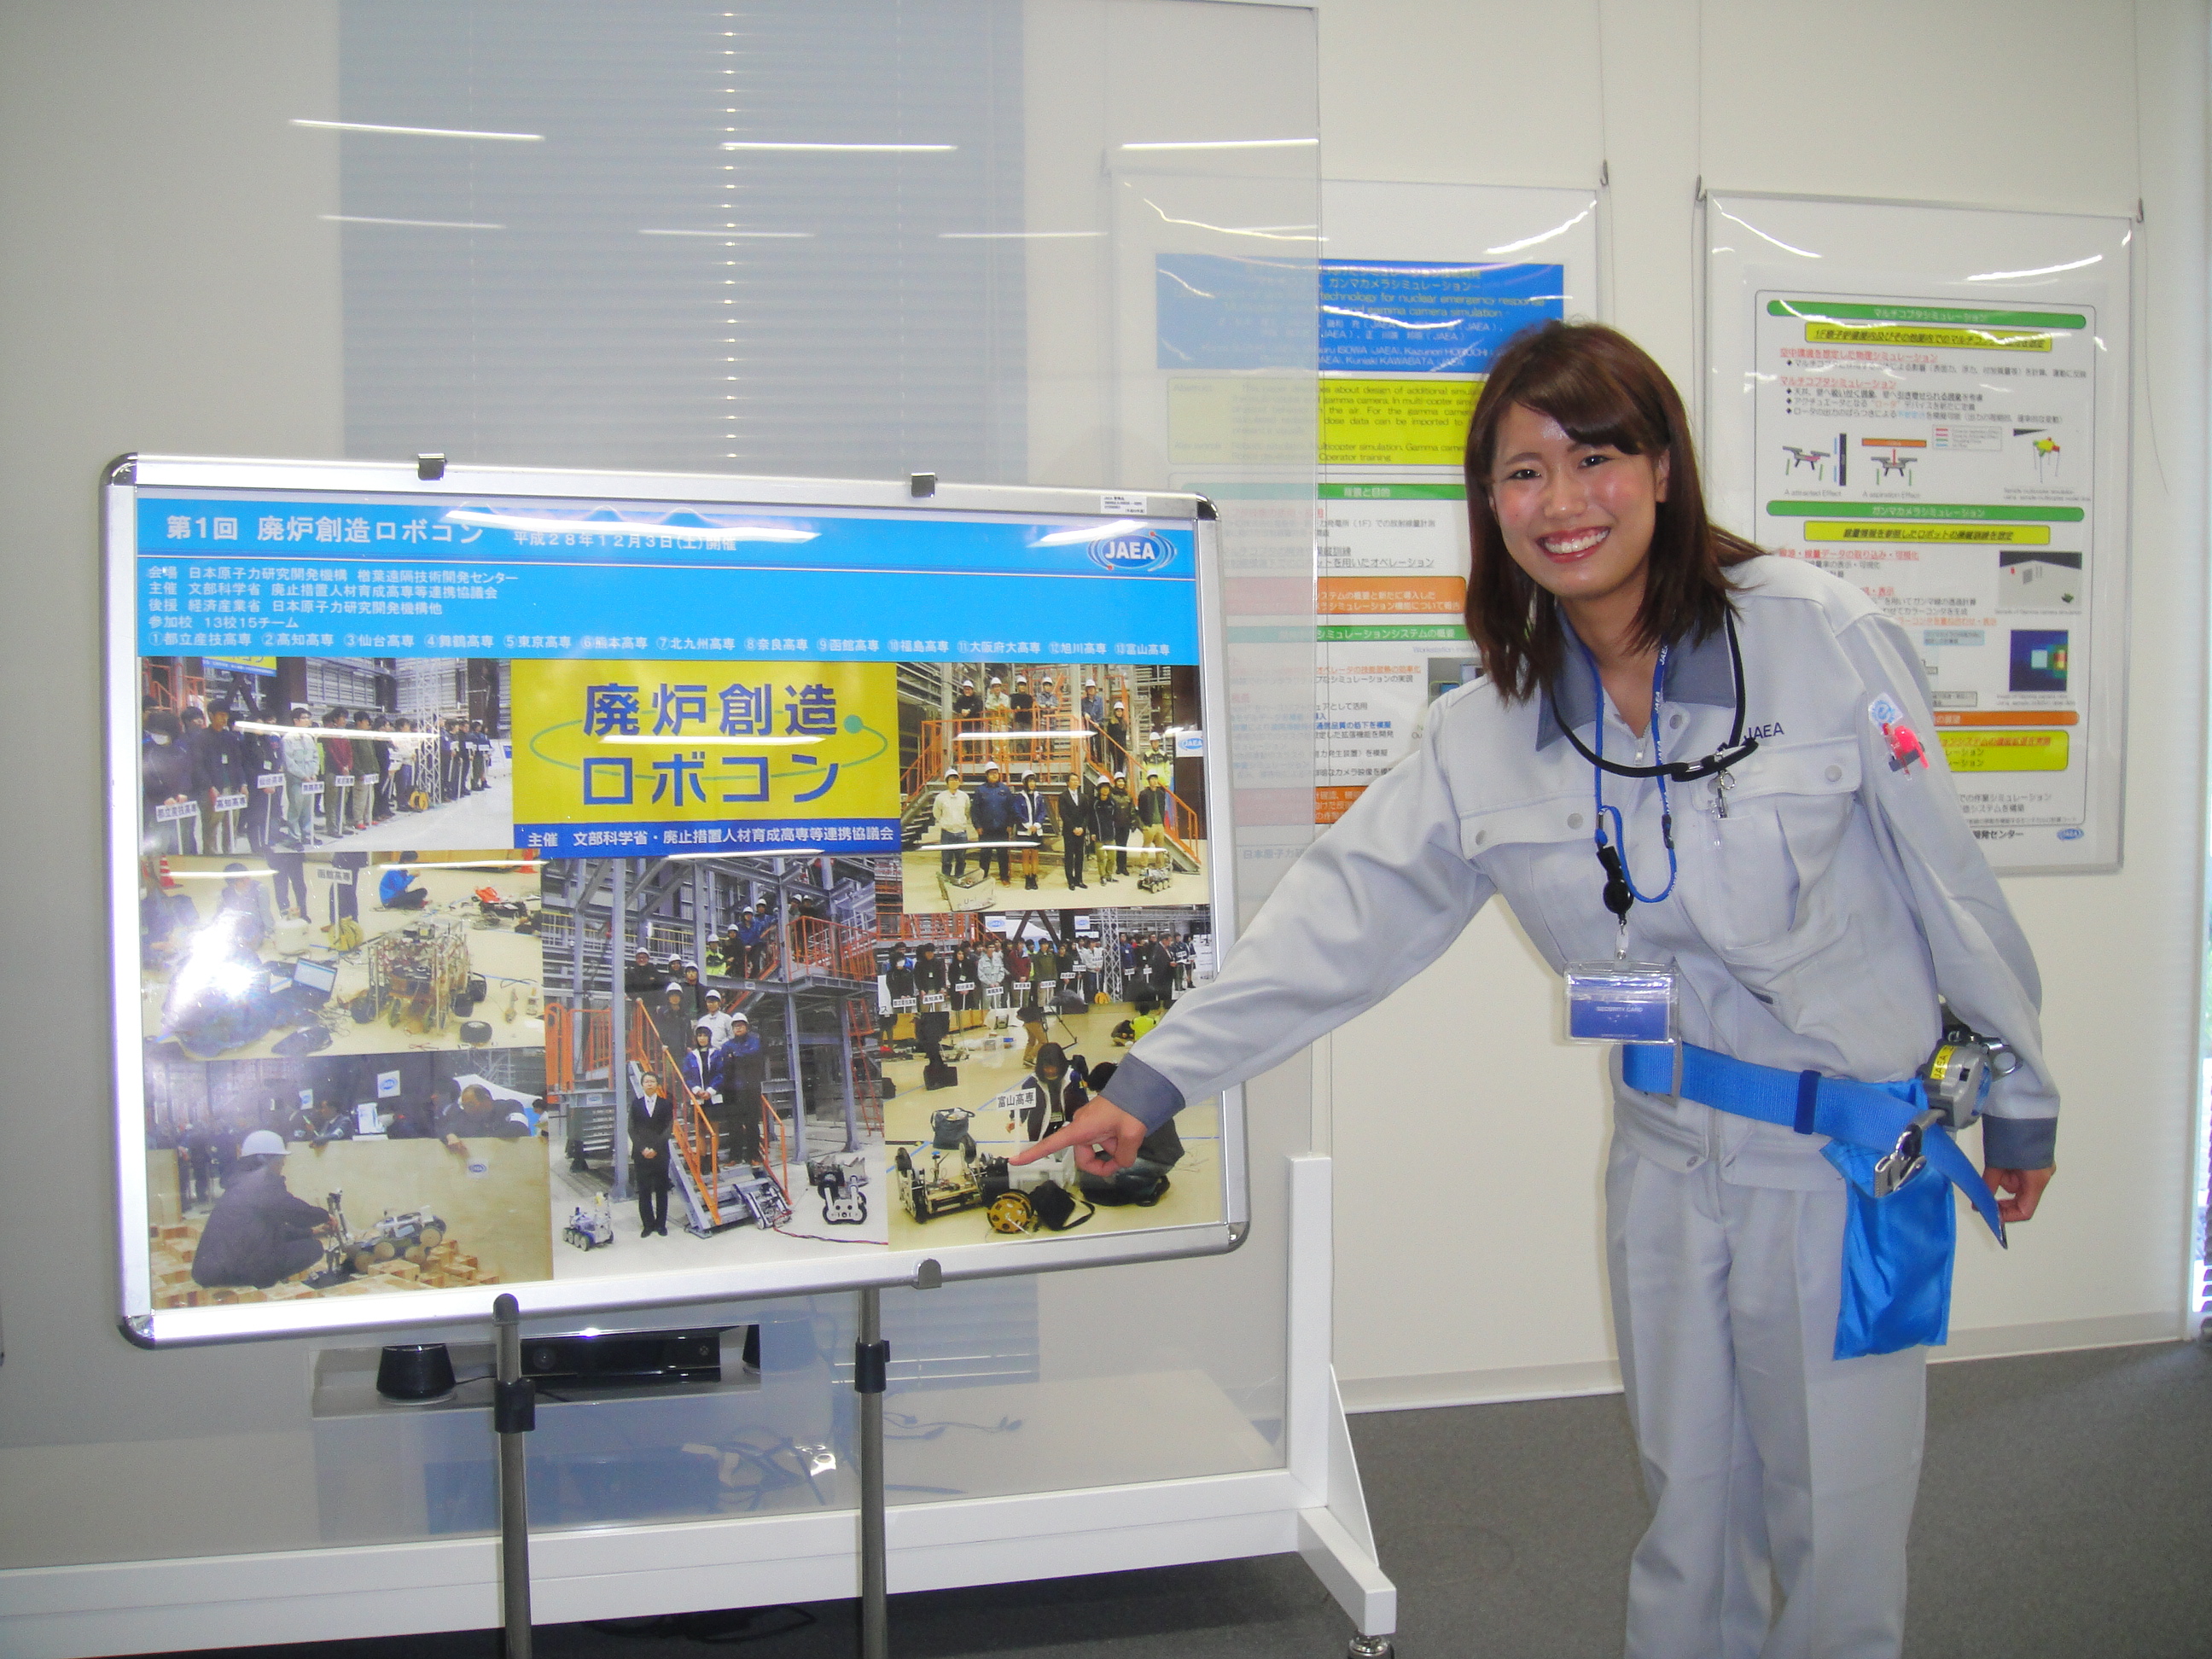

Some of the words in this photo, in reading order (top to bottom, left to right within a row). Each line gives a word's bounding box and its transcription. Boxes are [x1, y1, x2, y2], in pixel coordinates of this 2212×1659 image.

[166, 515, 238, 540] 第1回
[257, 515, 484, 544] 廃炉創造ロボコン
[1104, 540, 1156, 561] JAEA
[148, 566, 178, 580] 会場
[189, 567, 348, 582] 日本原子力研究開発機構
[357, 568, 519, 585] 楢葉遠隔技術開発センター
[148, 581, 178, 596] 主催
[188, 582, 261, 597] 文部科学省
[148, 598, 178, 613] 後援
[188, 599, 261, 614] 経済産業省
[271, 599, 443, 615] 日本原子力研究開発機構他
[148, 615, 193, 630] 参加校
[204, 616, 299, 630] 13校15チーム
[583, 682, 839, 737] 廃炉創造
[582, 750, 839, 807] ロボコン
[527, 832, 559, 848] 主催
[997, 1091, 1034, 1109] 富山高専
